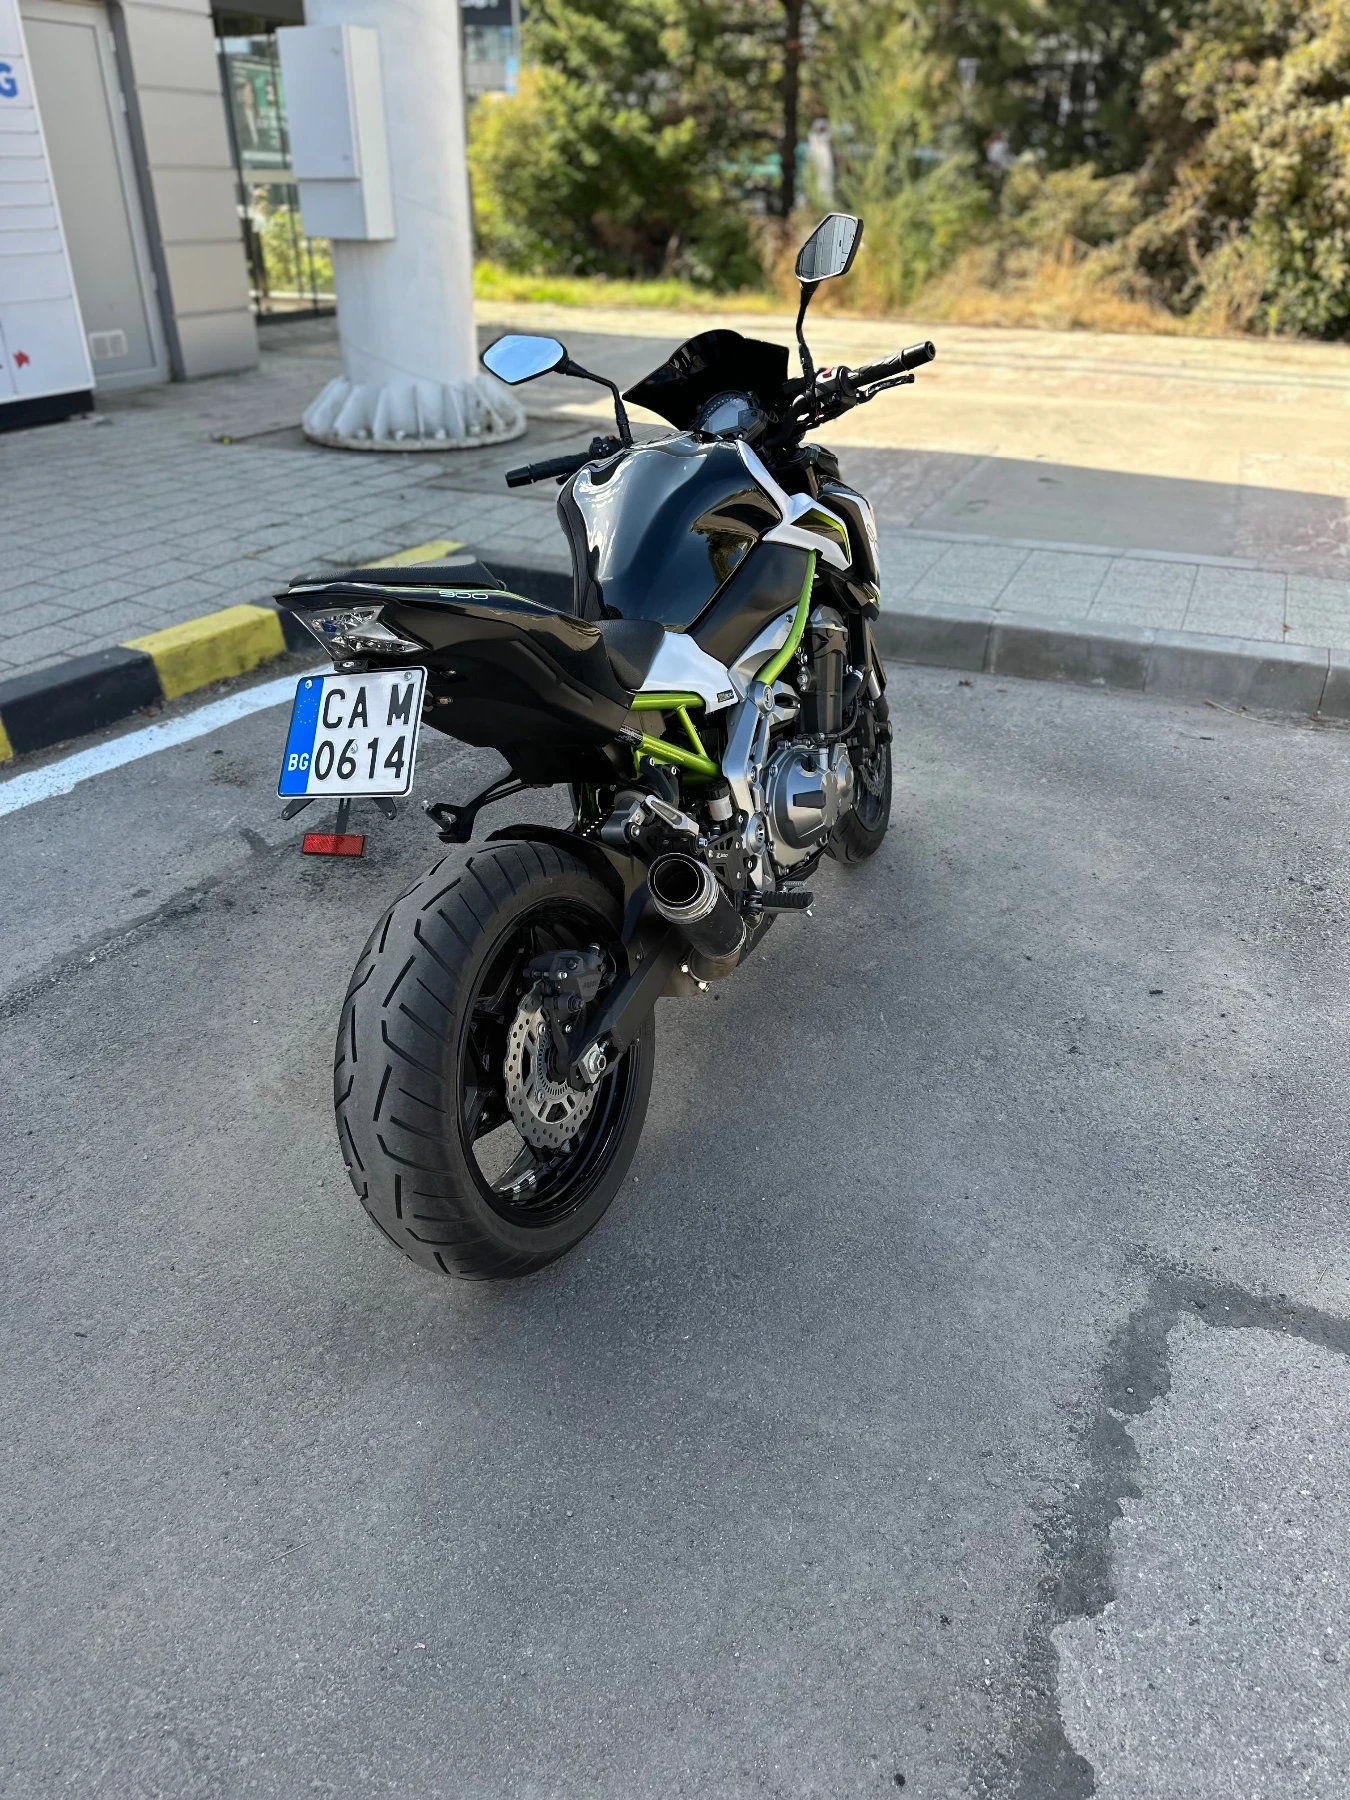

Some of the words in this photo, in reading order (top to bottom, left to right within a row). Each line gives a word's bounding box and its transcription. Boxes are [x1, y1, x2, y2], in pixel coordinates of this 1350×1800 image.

[438, 590, 489, 600] 900
[322, 686, 368, 729] CA
[386, 683, 415, 726] M
[287, 752, 310, 772] BG
[314, 735, 406, 781] 0614
